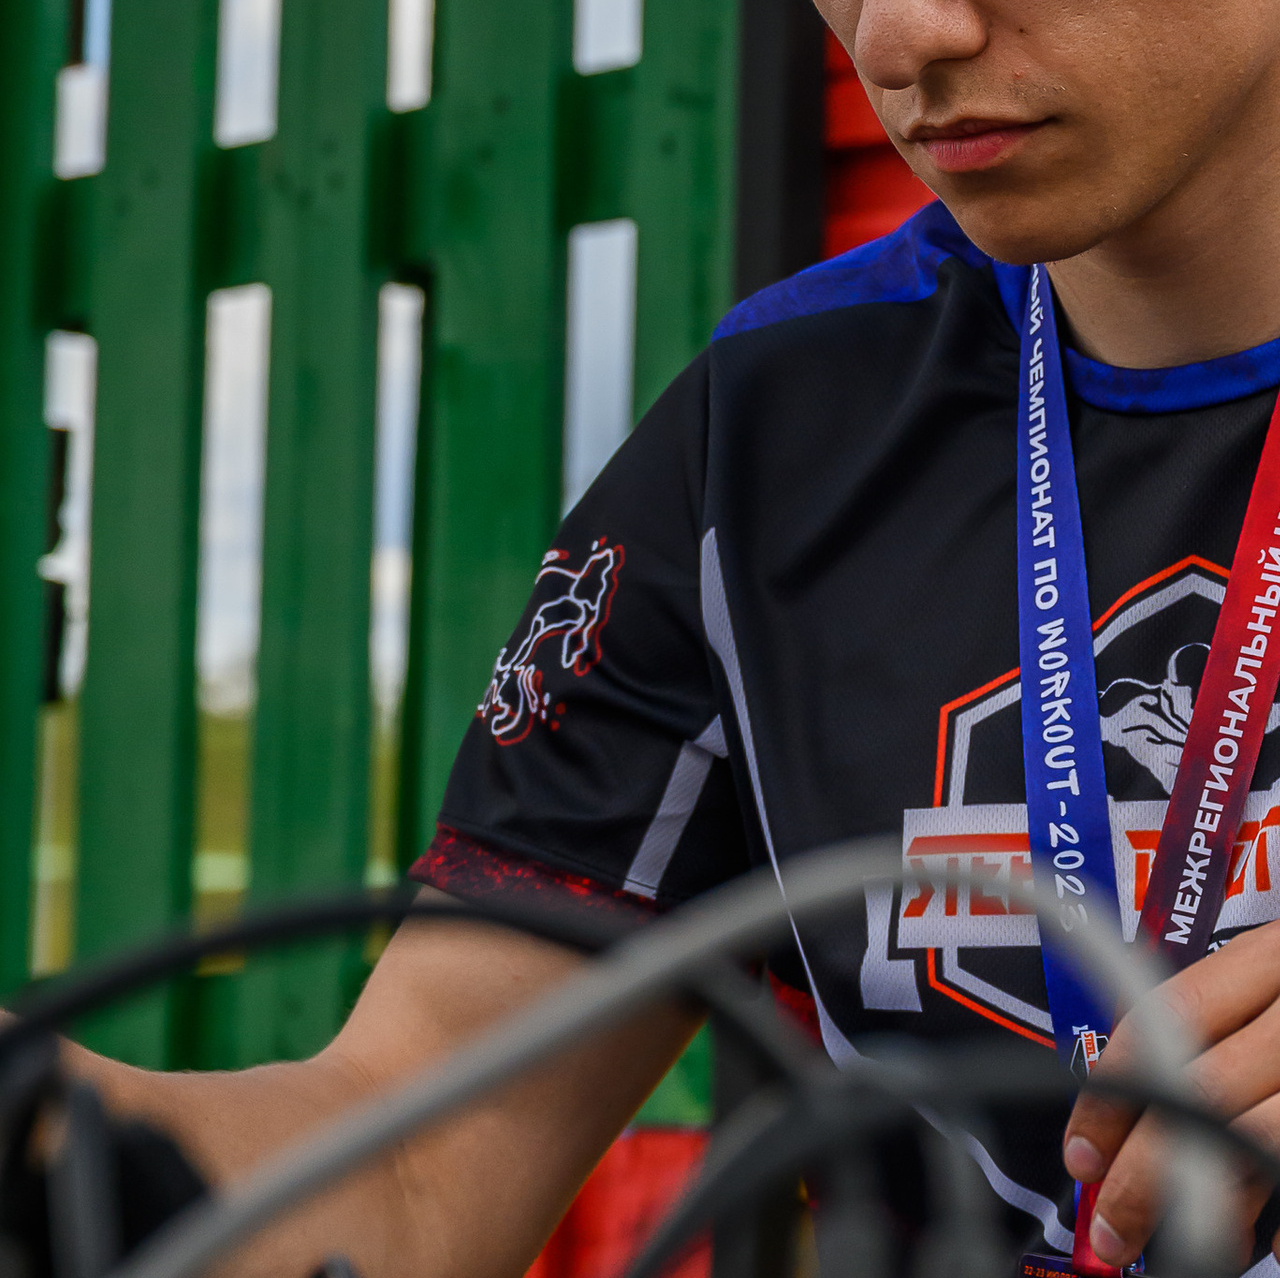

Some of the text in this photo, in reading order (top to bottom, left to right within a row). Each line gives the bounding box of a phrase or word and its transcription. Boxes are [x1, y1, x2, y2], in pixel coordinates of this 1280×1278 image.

[1028, 337, 1056, 549] ЧЕМПИОНАТ
[1033, 561, 1060, 611] ПО
[1036, 618, 1089, 932] WORKOUT-2023
[903, 833, 1038, 918] STEE
[1024, 1265, 1045, 1278] 22-23
